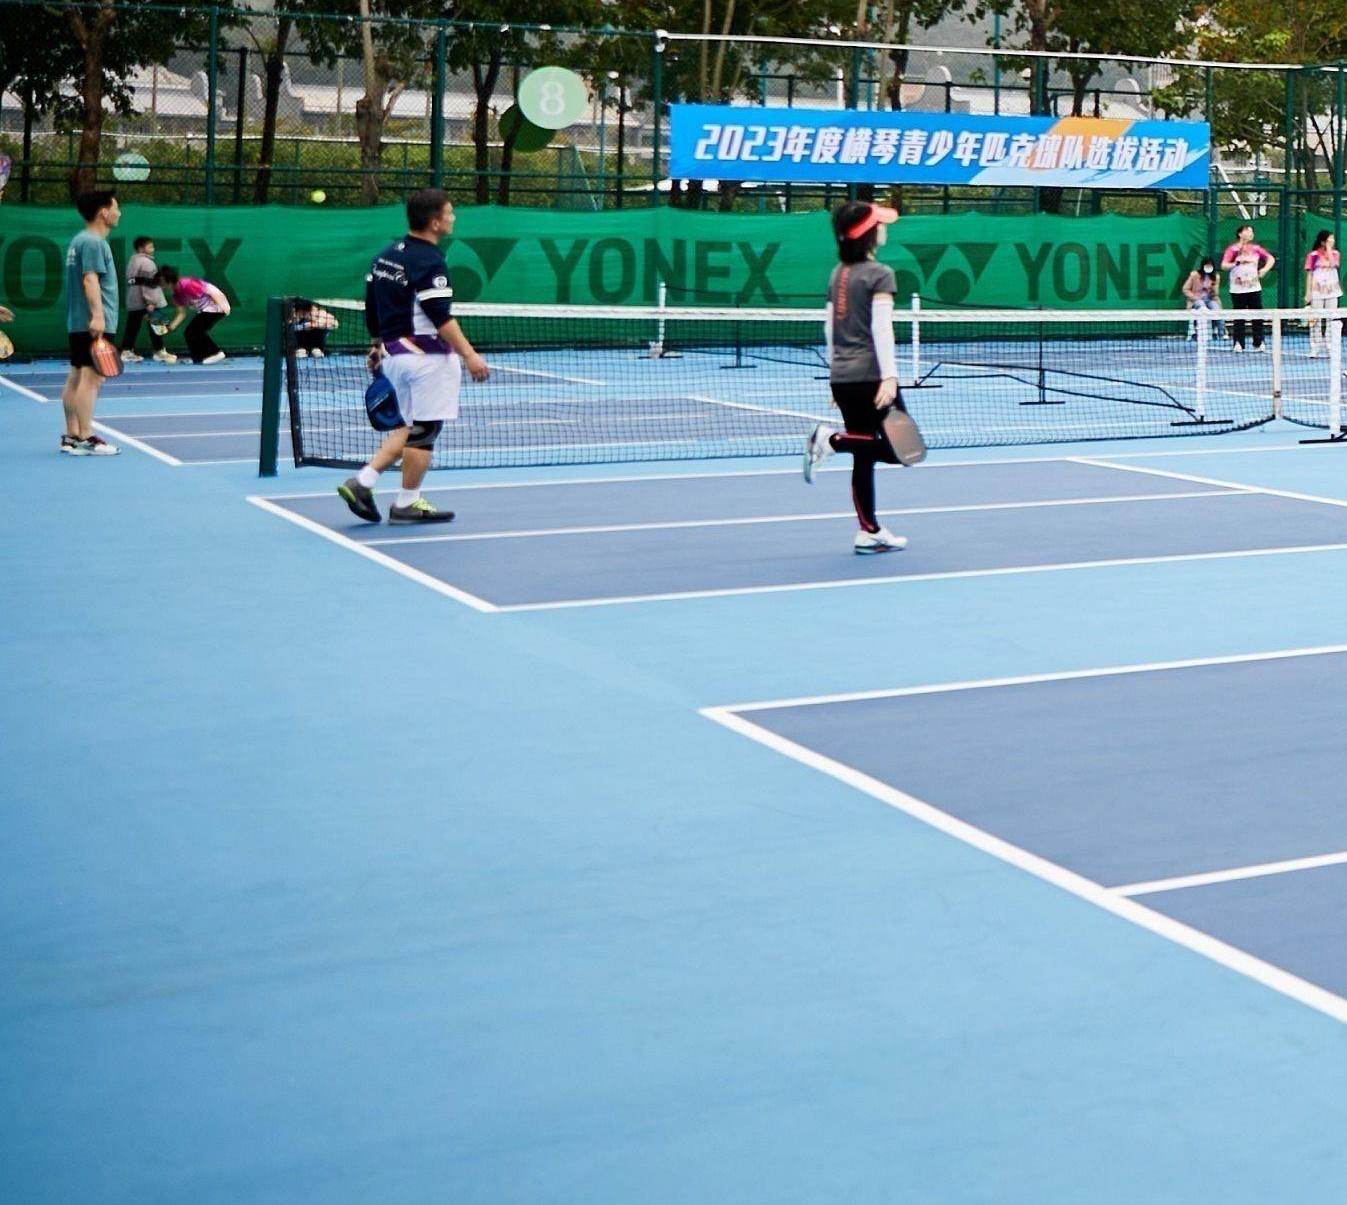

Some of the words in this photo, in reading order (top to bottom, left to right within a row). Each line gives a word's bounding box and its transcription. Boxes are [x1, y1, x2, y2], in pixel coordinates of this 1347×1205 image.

[540, 81, 565, 115] 8
[694, 123, 1189, 172] 2023年度横琴青少年匹克球队选拔活动
[538, 237, 782, 304] YONEX
